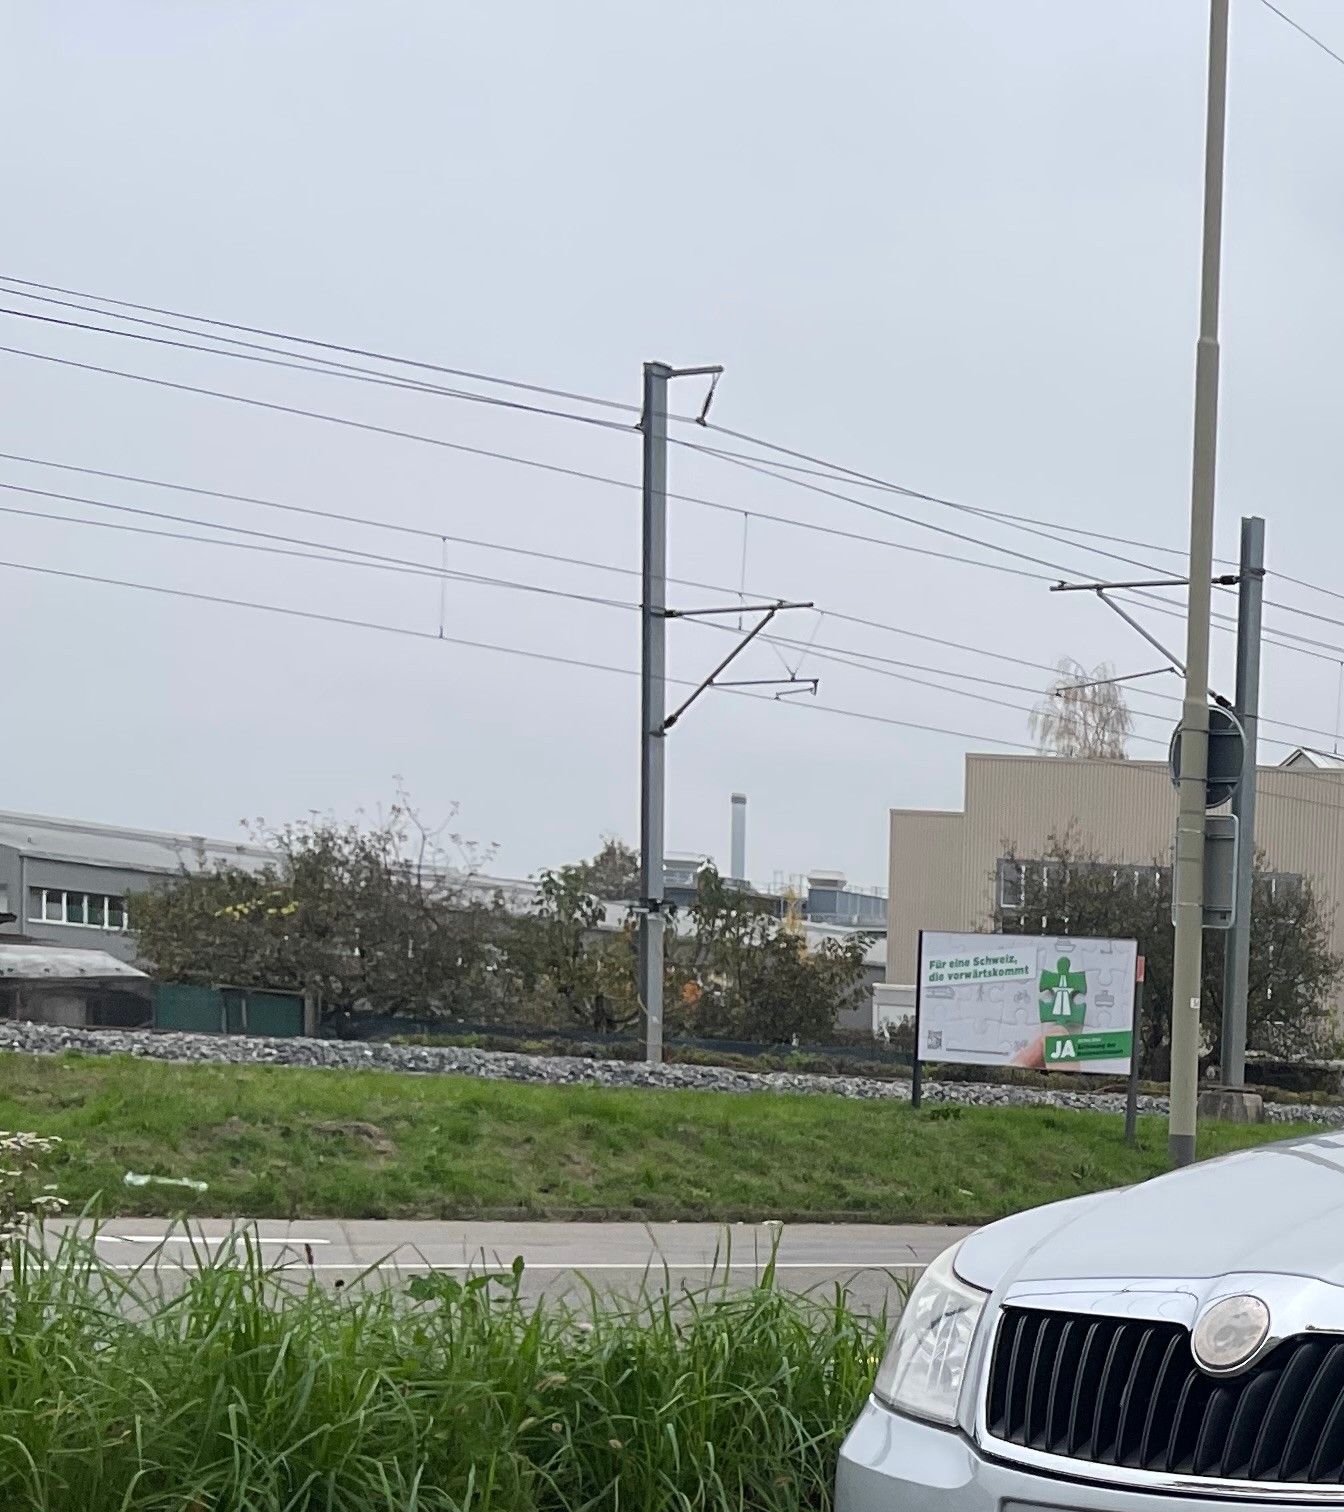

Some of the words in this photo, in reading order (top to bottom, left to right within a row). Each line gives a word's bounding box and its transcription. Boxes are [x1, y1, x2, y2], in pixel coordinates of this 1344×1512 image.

[929, 959, 946, 970] Für
[949, 957, 970, 968] eine
[973, 953, 1018, 967] Schweiz,
[928, 971, 944, 982] die
[947, 964, 1029, 981] vorwärtskommt
[1050, 1038, 1076, 1060] JA
